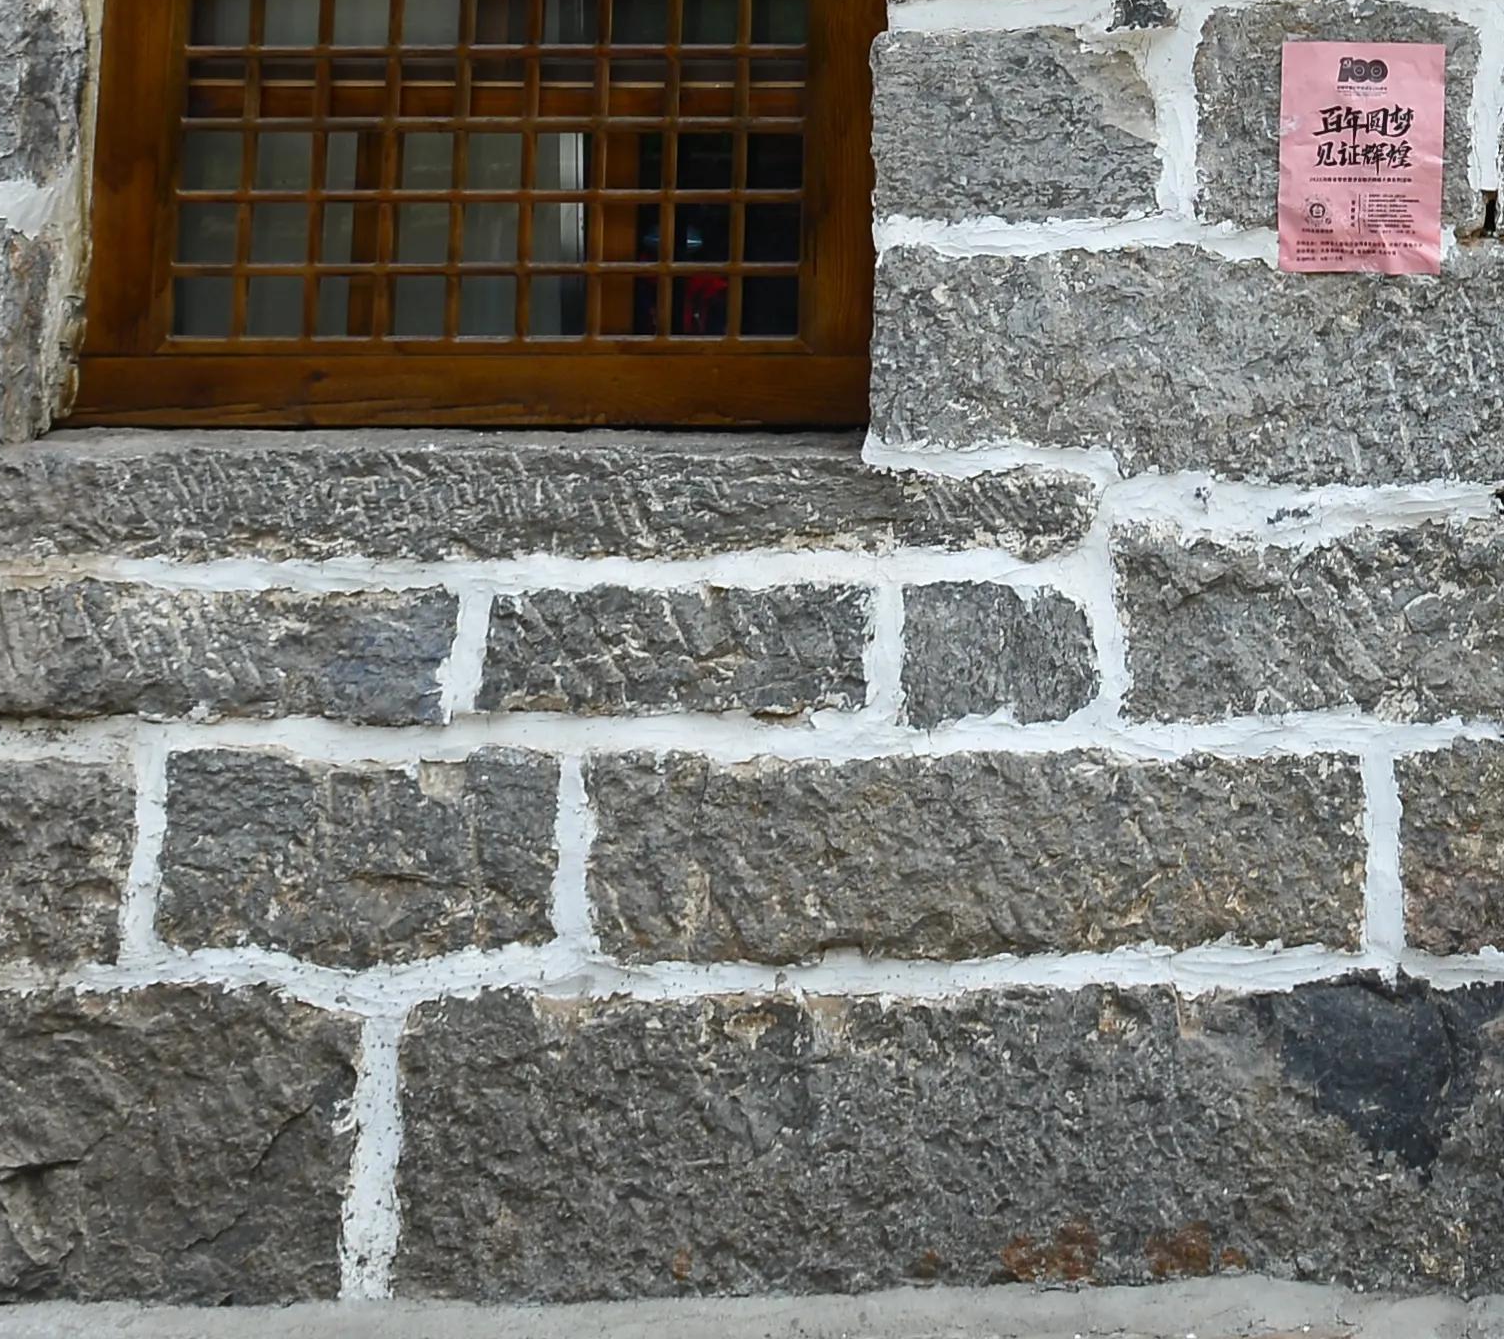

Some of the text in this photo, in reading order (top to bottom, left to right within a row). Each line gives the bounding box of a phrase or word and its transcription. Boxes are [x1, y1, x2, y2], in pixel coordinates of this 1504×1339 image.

[1312, 104, 1414, 143] 百年圆梦
[1314, 140, 1413, 176] 见证辉煌
